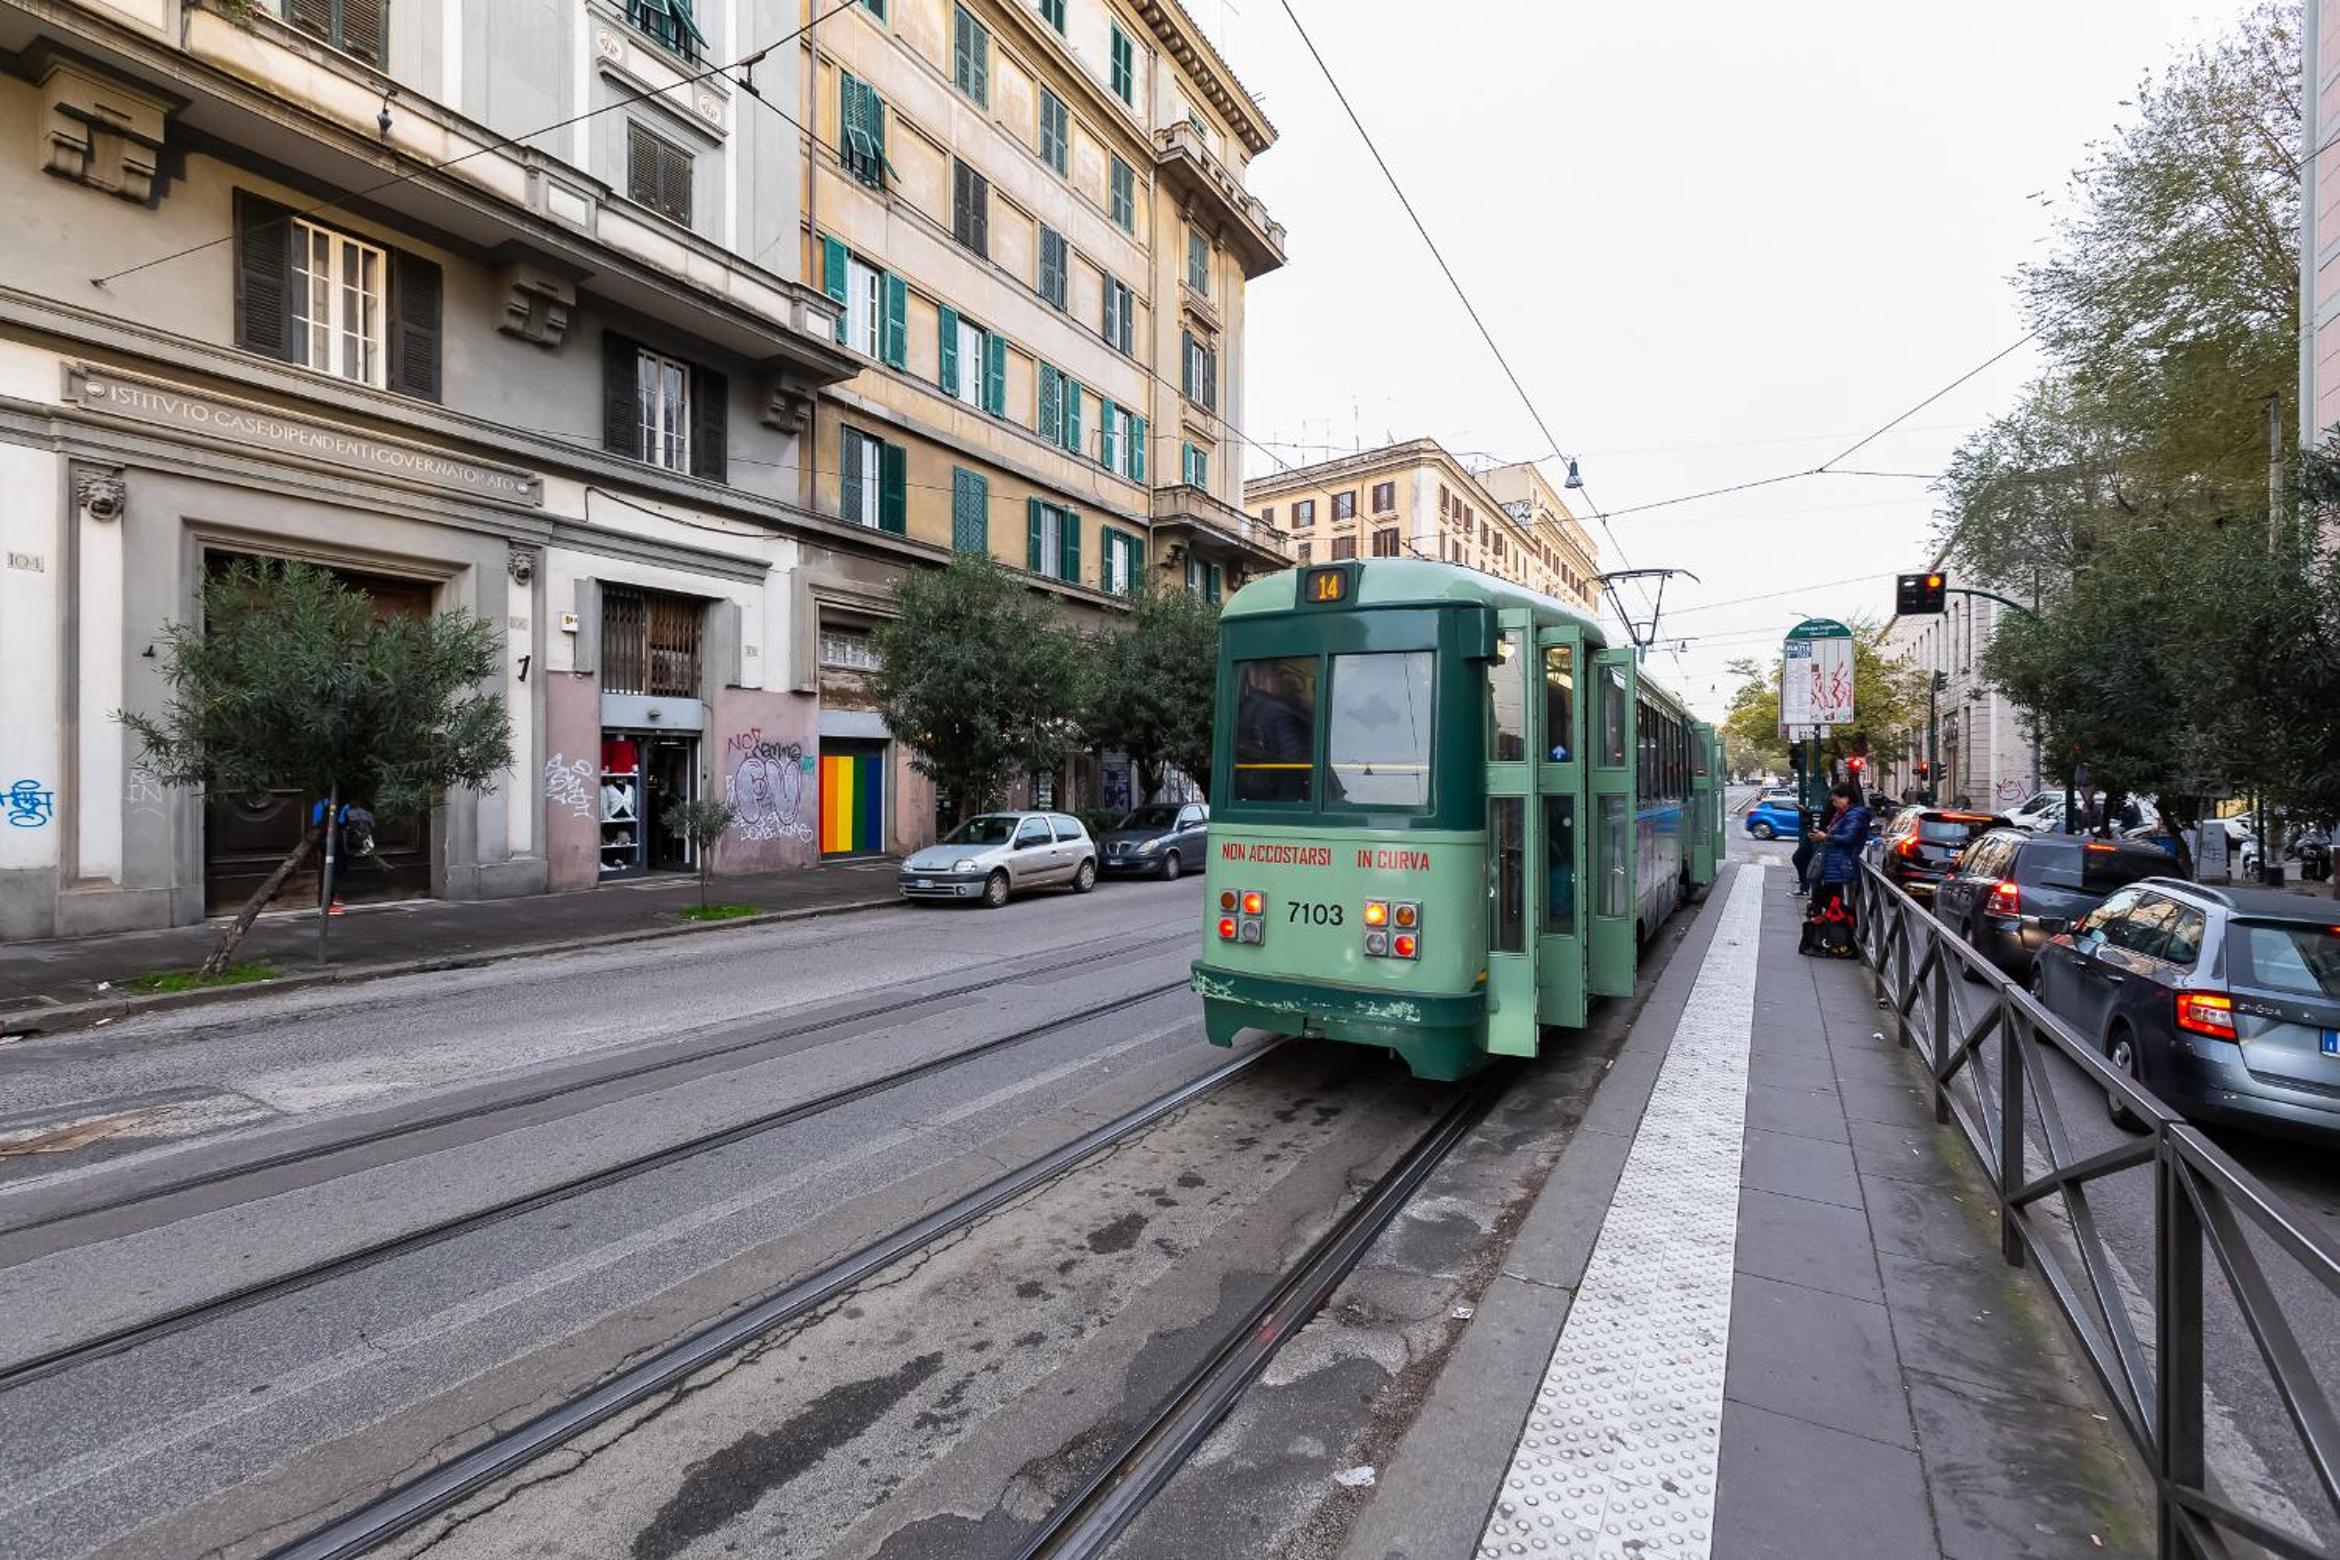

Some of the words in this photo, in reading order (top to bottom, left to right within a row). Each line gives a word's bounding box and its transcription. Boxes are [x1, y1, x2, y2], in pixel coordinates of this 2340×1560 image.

[1319, 575, 1338, 600] 14
[1222, 843, 1246, 861] NON
[1249, 844, 1332, 866] ACCOSTARSI
[1356, 849, 1373, 868] IN
[1377, 849, 1431, 871] CURVA
[1287, 901, 1345, 926] 7103
